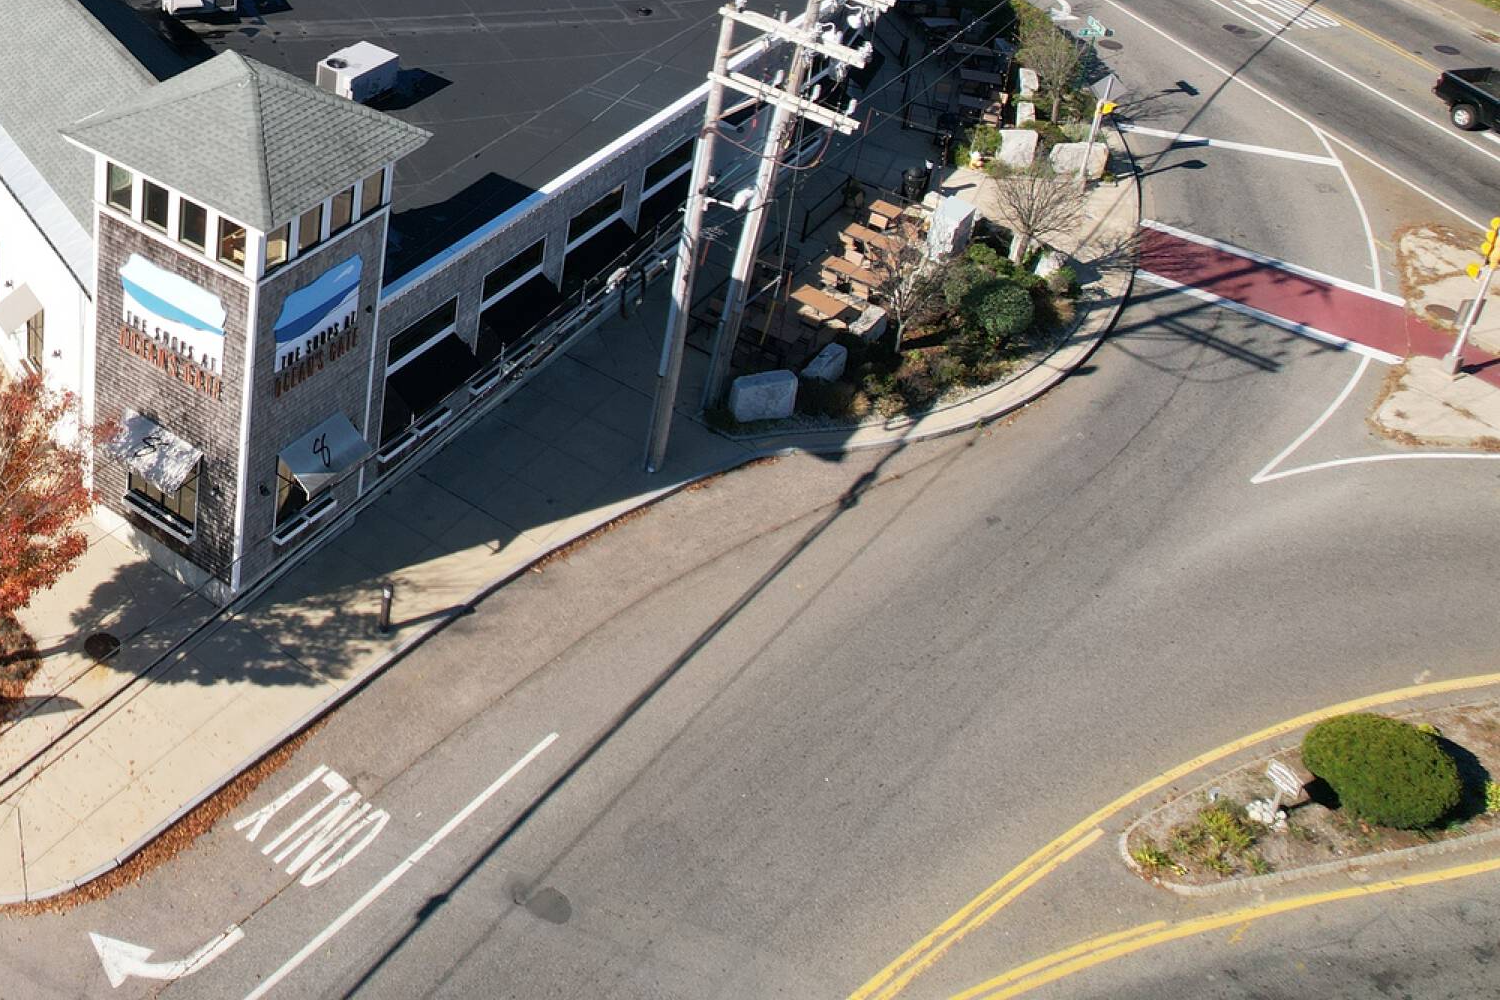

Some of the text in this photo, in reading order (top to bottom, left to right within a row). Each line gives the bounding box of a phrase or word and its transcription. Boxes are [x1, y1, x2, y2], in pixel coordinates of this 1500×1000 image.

[127, 310, 217, 371] THE SHOPS AT
[281, 310, 357, 370] THE SHOPS AT
[330, 327, 360, 362] GATE
[183, 362, 224, 401] GATE
[233, 764, 391, 887] ONLY
